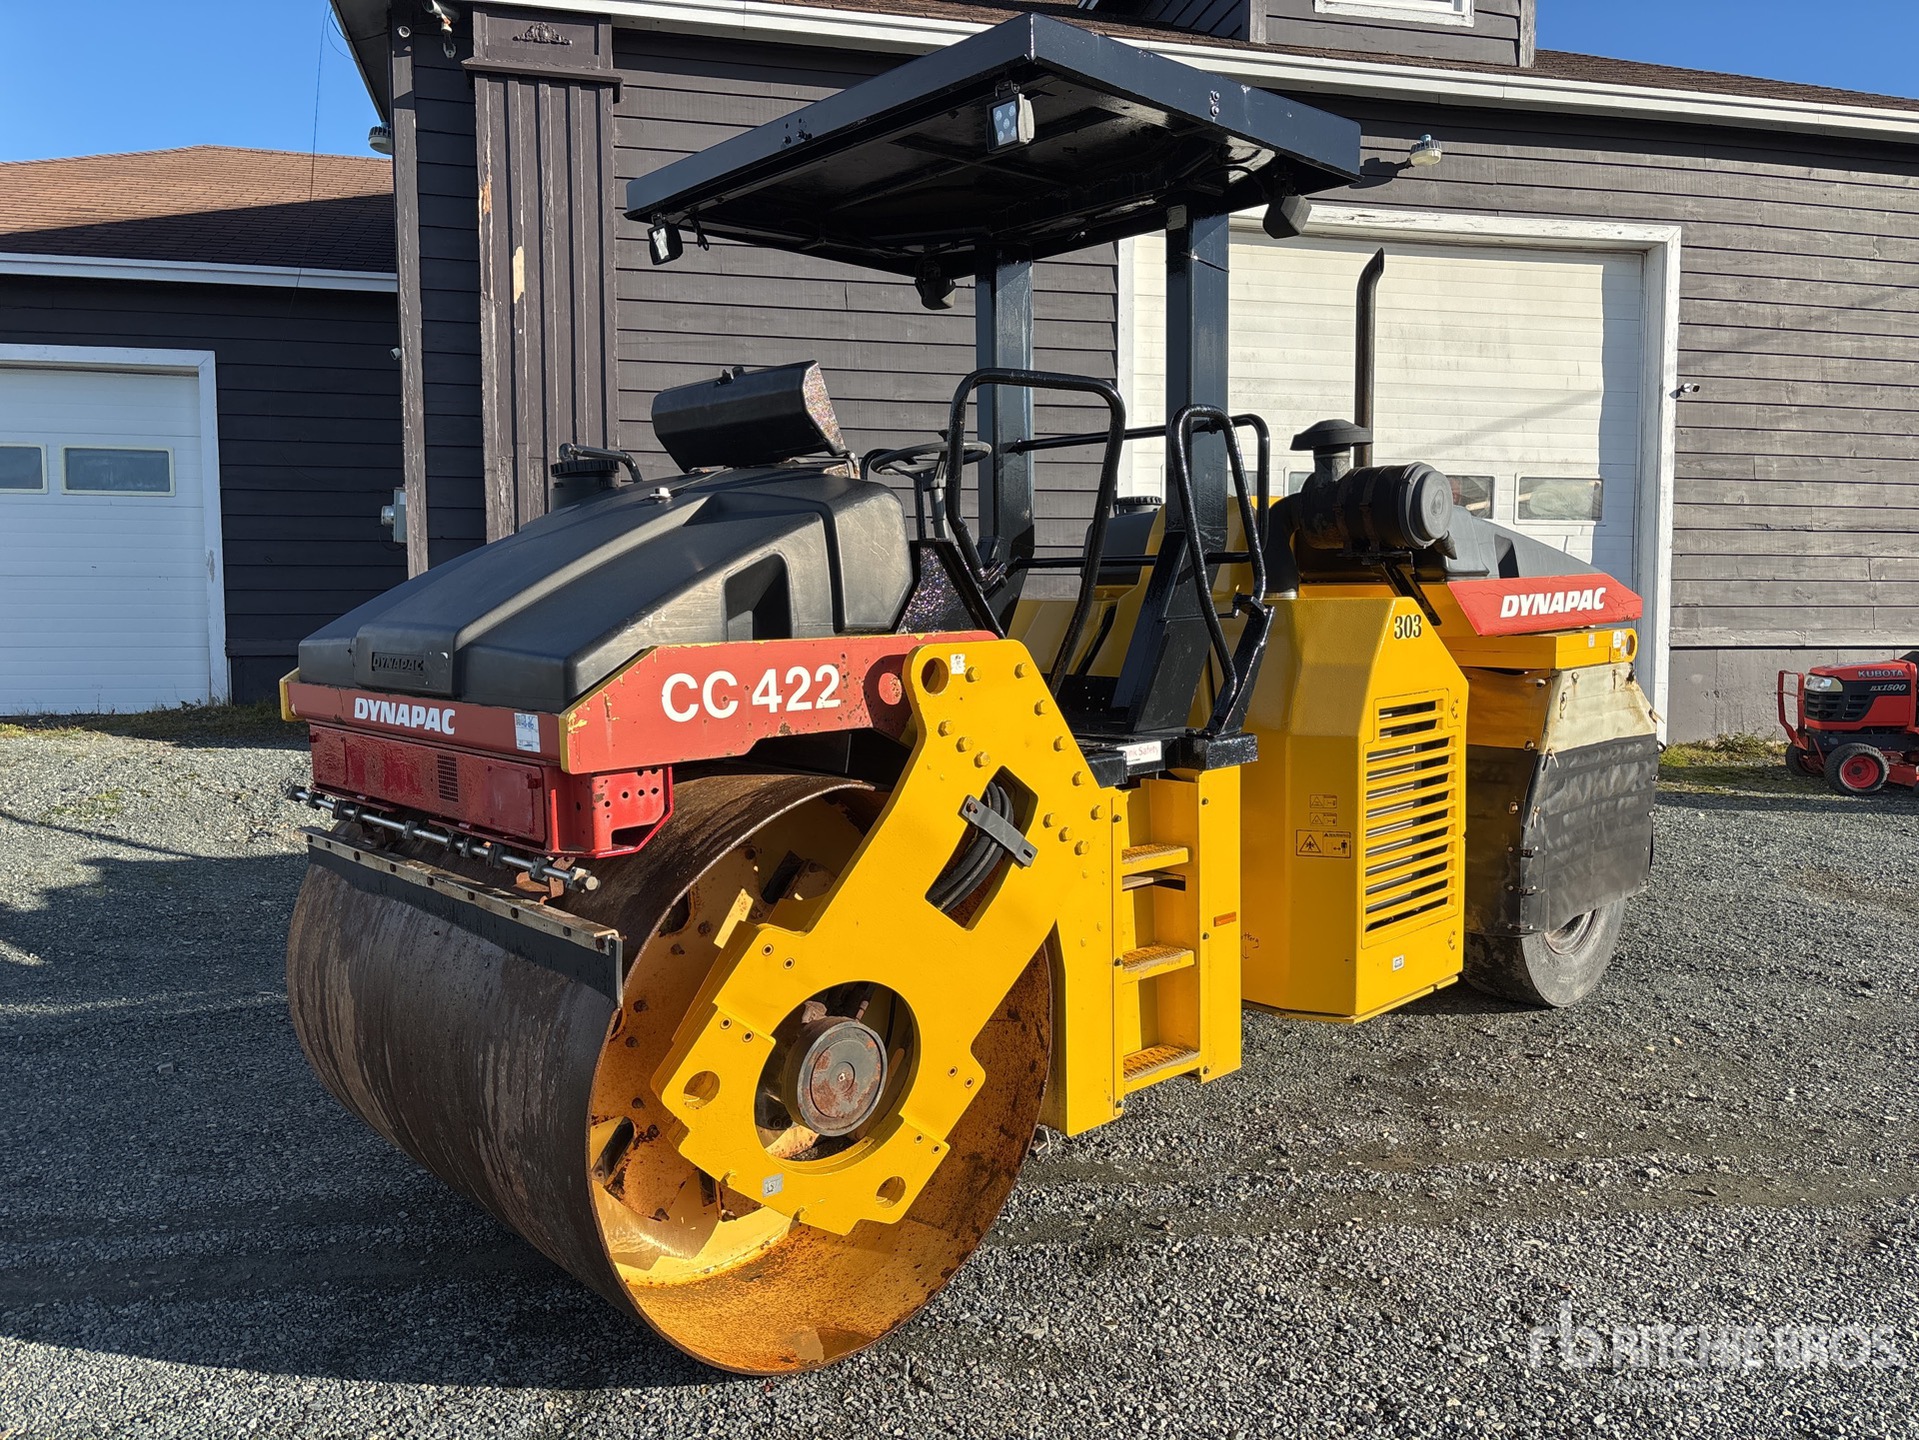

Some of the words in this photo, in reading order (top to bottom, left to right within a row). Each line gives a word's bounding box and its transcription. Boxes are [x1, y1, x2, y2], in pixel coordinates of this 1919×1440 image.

[1500, 587, 1606, 618] DYNAPAC
[1394, 614, 1422, 639] 303
[374, 656, 424, 670] DYNAPAC
[661, 670, 739, 722] CC
[752, 664, 841, 713] 422
[354, 697, 456, 734] DYNAPAC
